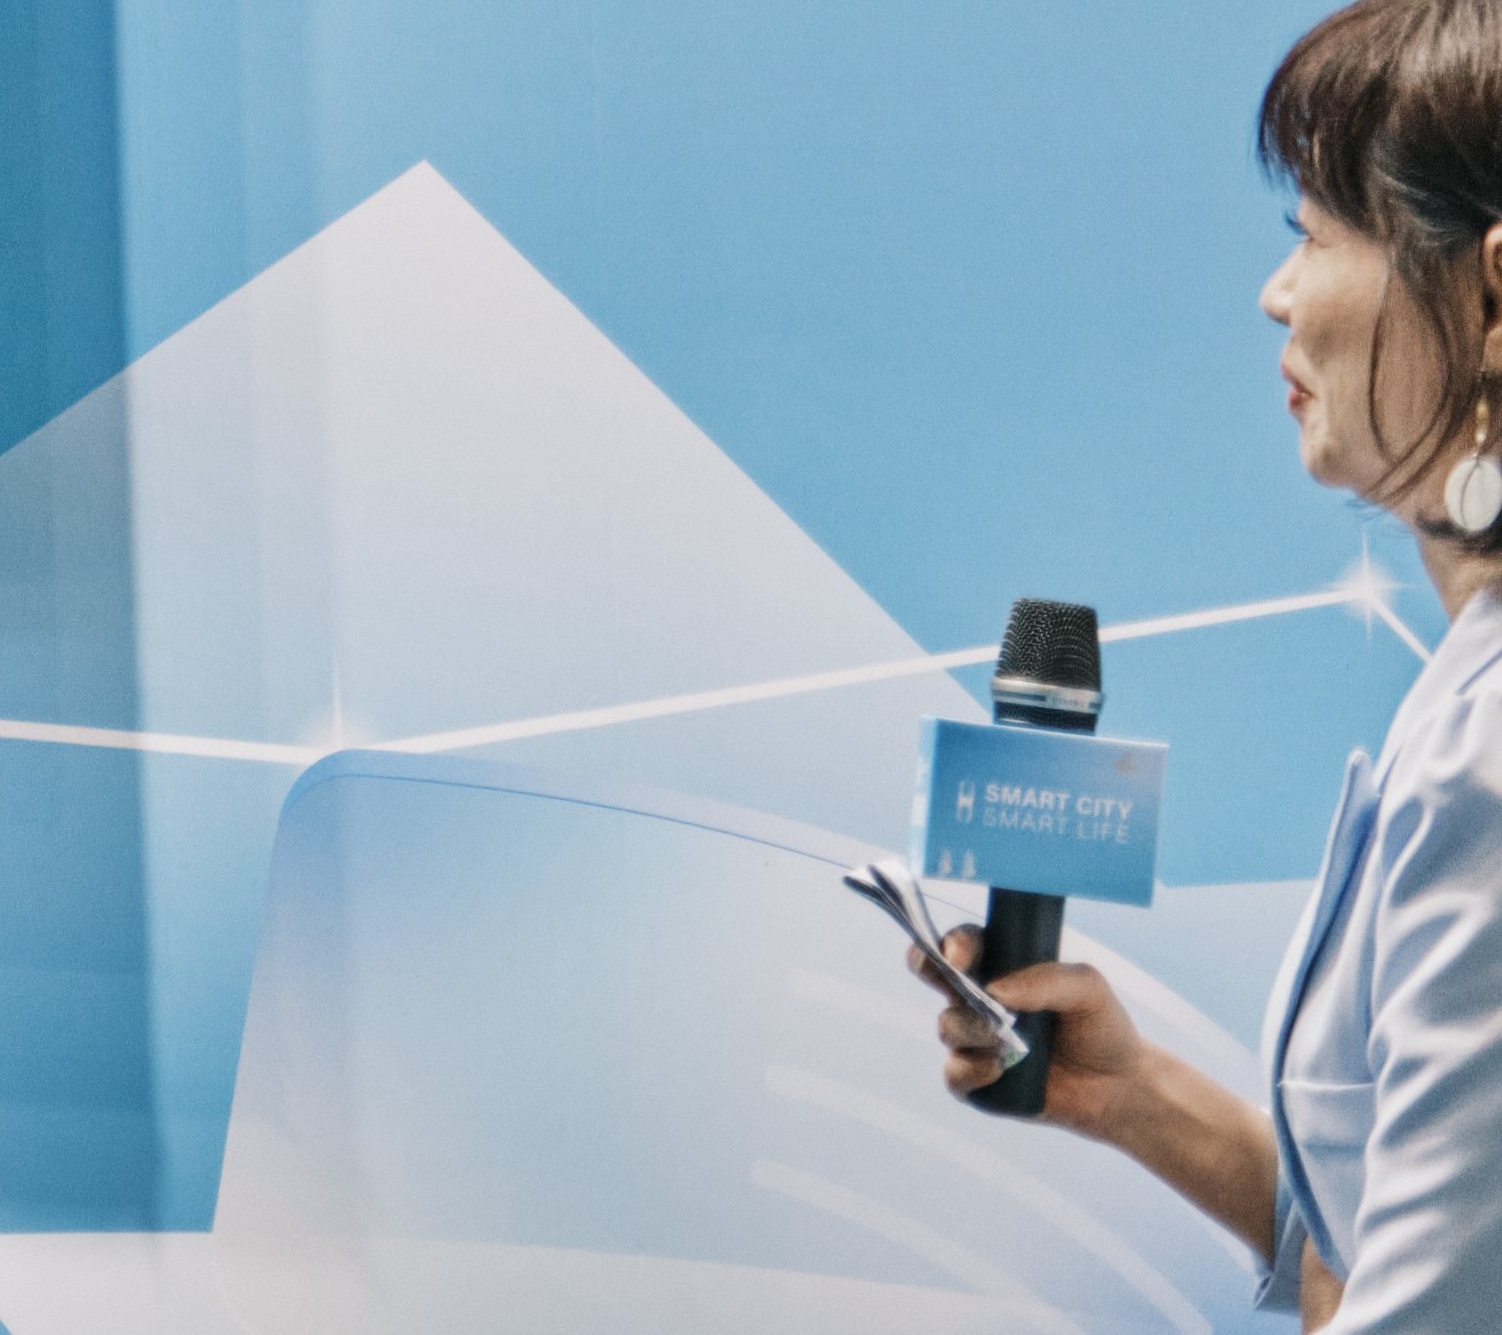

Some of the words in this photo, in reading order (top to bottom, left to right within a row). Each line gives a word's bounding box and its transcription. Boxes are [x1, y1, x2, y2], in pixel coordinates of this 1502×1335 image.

[984, 782, 1072, 811] SMART
[1076, 796, 1134, 820] CITY
[982, 807, 1071, 835] SMART
[1077, 820, 1130, 845] LIFE
